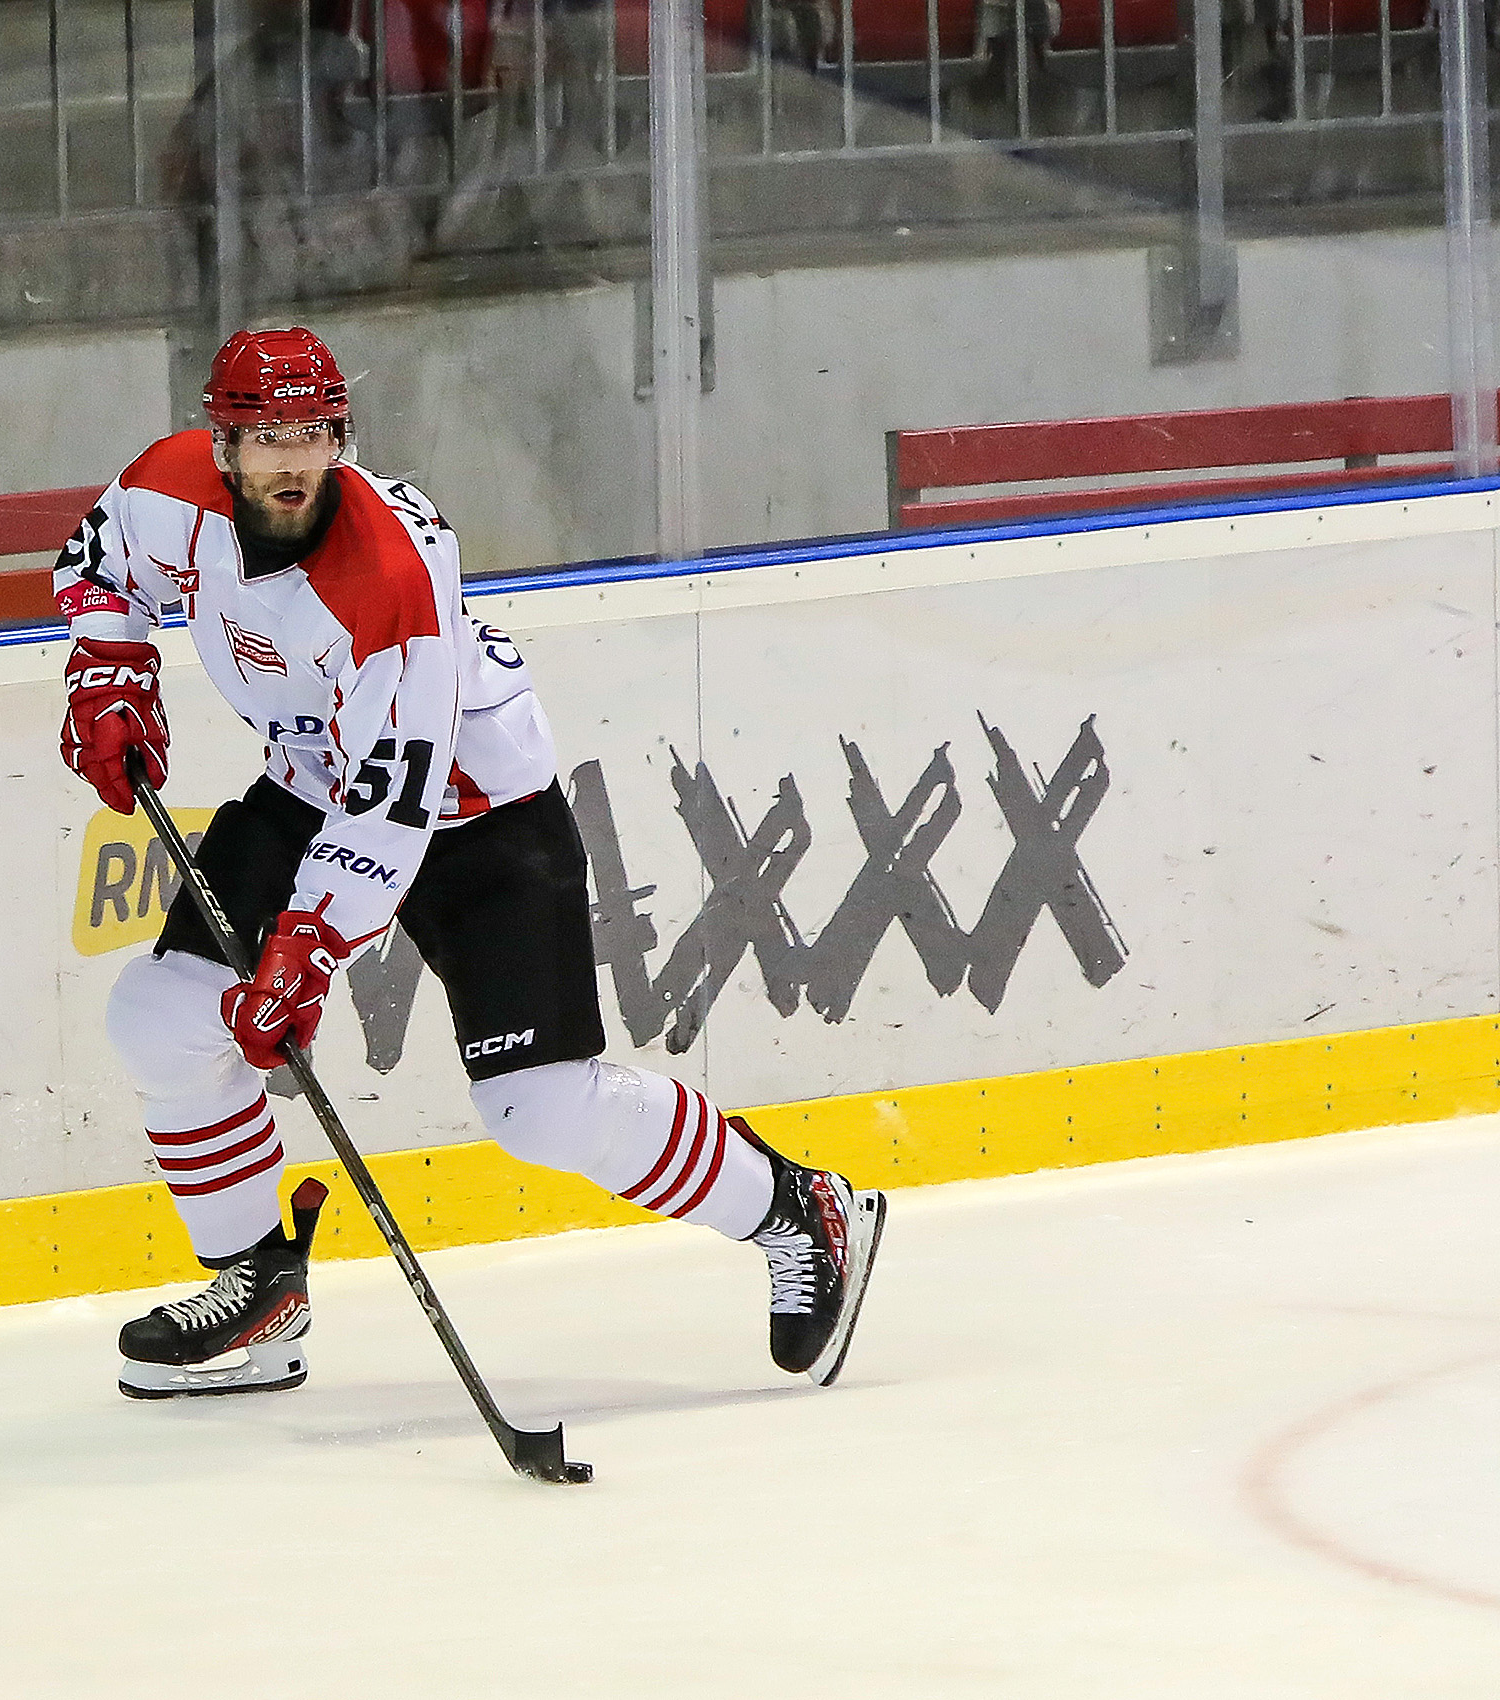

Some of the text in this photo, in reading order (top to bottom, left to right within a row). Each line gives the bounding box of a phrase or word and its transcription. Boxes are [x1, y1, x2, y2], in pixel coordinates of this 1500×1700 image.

[273, 385, 316, 398] CCM
[66, 665, 155, 693] CCM
[344, 738, 434, 830] 51
[465, 1028, 535, 1060] CCM
[248, 1298, 296, 1344] CCM
